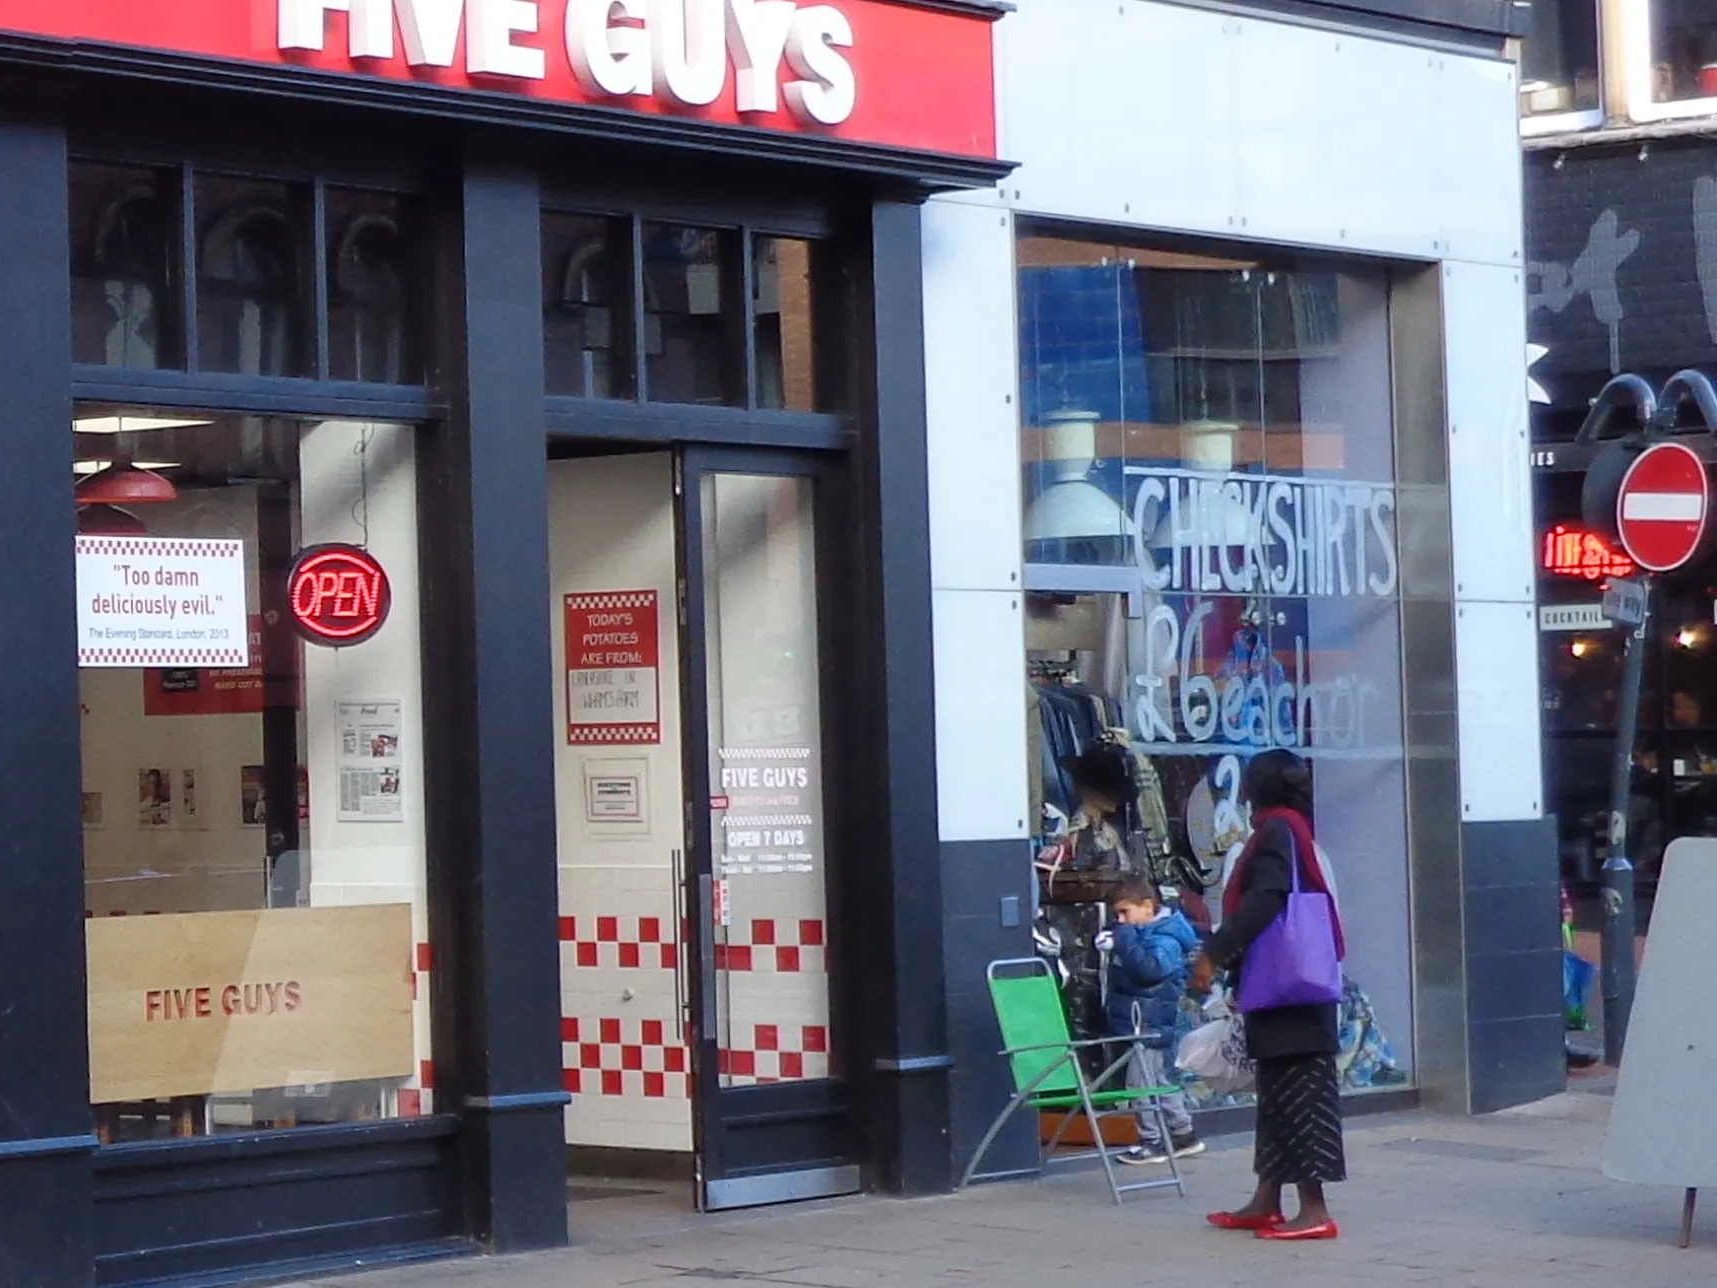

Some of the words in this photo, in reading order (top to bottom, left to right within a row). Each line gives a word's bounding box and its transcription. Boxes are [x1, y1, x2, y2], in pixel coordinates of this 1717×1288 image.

[113, 564, 150, 587] "Too
[154, 565, 199, 587] damn
[292, 572, 382, 617] OPEN
[92, 594, 176, 619] deliciously
[182, 595, 223, 615] evil."
[587, 613, 633, 627] TODAY'S
[1544, 611, 1607, 624] COCKTAIL
[89, 627, 104, 639] The
[105, 628, 136, 641] Evening
[139, 628, 173, 641] Standard,
[176, 629, 207, 640] London,
[209, 628, 230, 639] 2013
[583, 632, 639, 646] POTATOES
[581, 652, 604, 665] ARE
[606, 651, 642, 664] FROM:
[721, 768, 759, 788] FIVE
[763, 767, 808, 788] GUYS
[728, 831, 760, 848] OPEN
[764, 831, 771, 847] 7
[774, 830, 804, 847] DAYS
[145, 987, 211, 1022] FIVE
[222, 981, 302, 1015] GUYS
